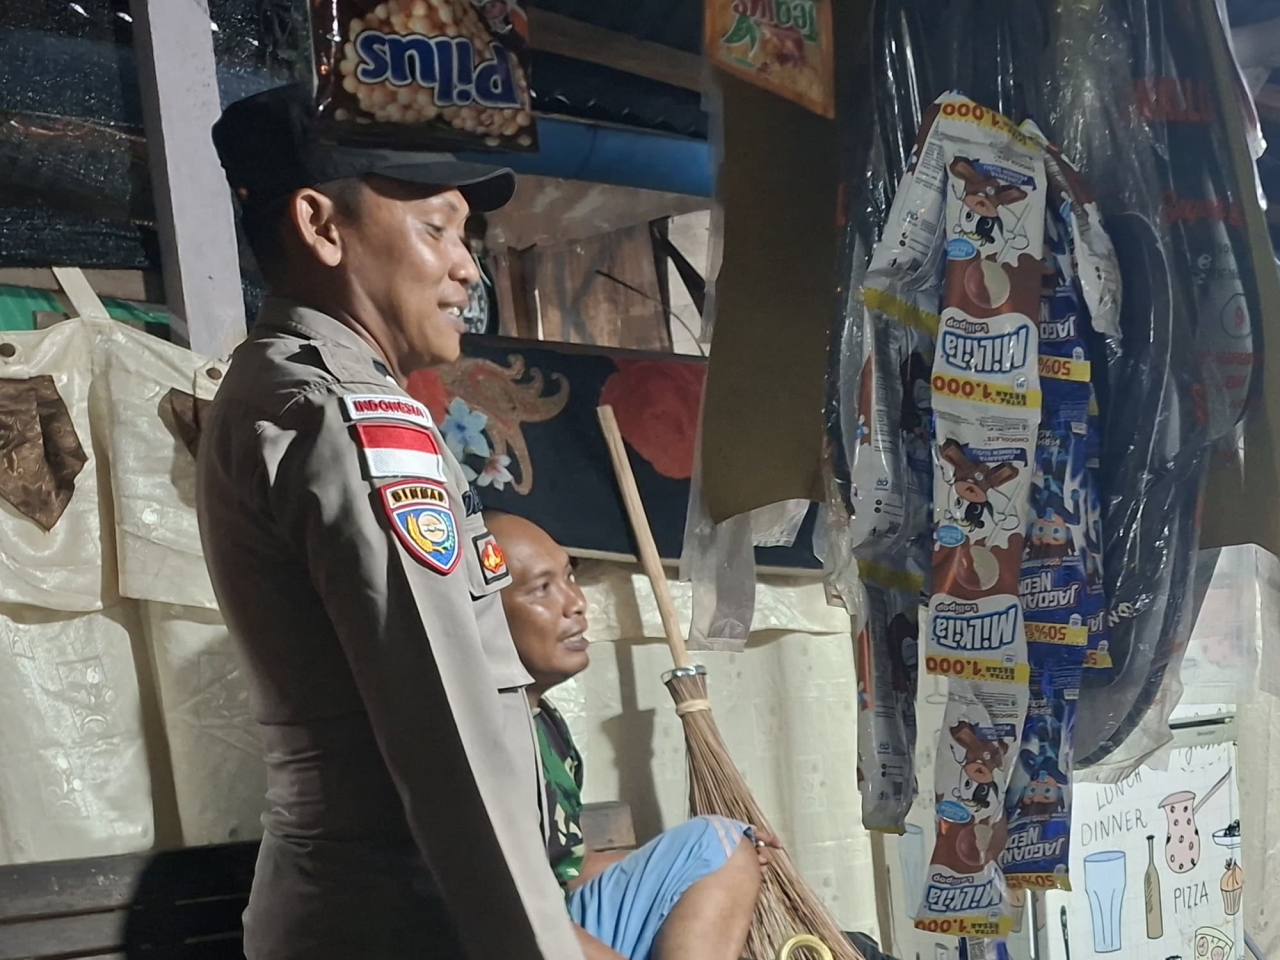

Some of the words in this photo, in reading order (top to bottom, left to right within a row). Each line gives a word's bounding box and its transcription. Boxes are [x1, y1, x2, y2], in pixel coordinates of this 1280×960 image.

[355, 30, 521, 109] Pilus
[946, 318, 989, 334] Lollipop
[1039, 314, 1077, 340] JAGO
[1038, 357, 1071, 377] 50%
[932, 376, 993, 400] 1.000
[352, 400, 425, 419] INDONESIA
[935, 601, 979, 614] Lollipop
[1034, 624, 1067, 641] 50%
[926, 657, 983, 676] 1.000
[985, 666, 1015, 675] BESAR
[989, 672, 1015, 681] EXTRA
[1095, 768, 1142, 812] LUNCH
[1005, 825, 1041, 848] NEO
[1081, 808, 1149, 847] DINNER
[932, 873, 975, 885] Lollipop
[1173, 881, 1209, 914] PIZZA
